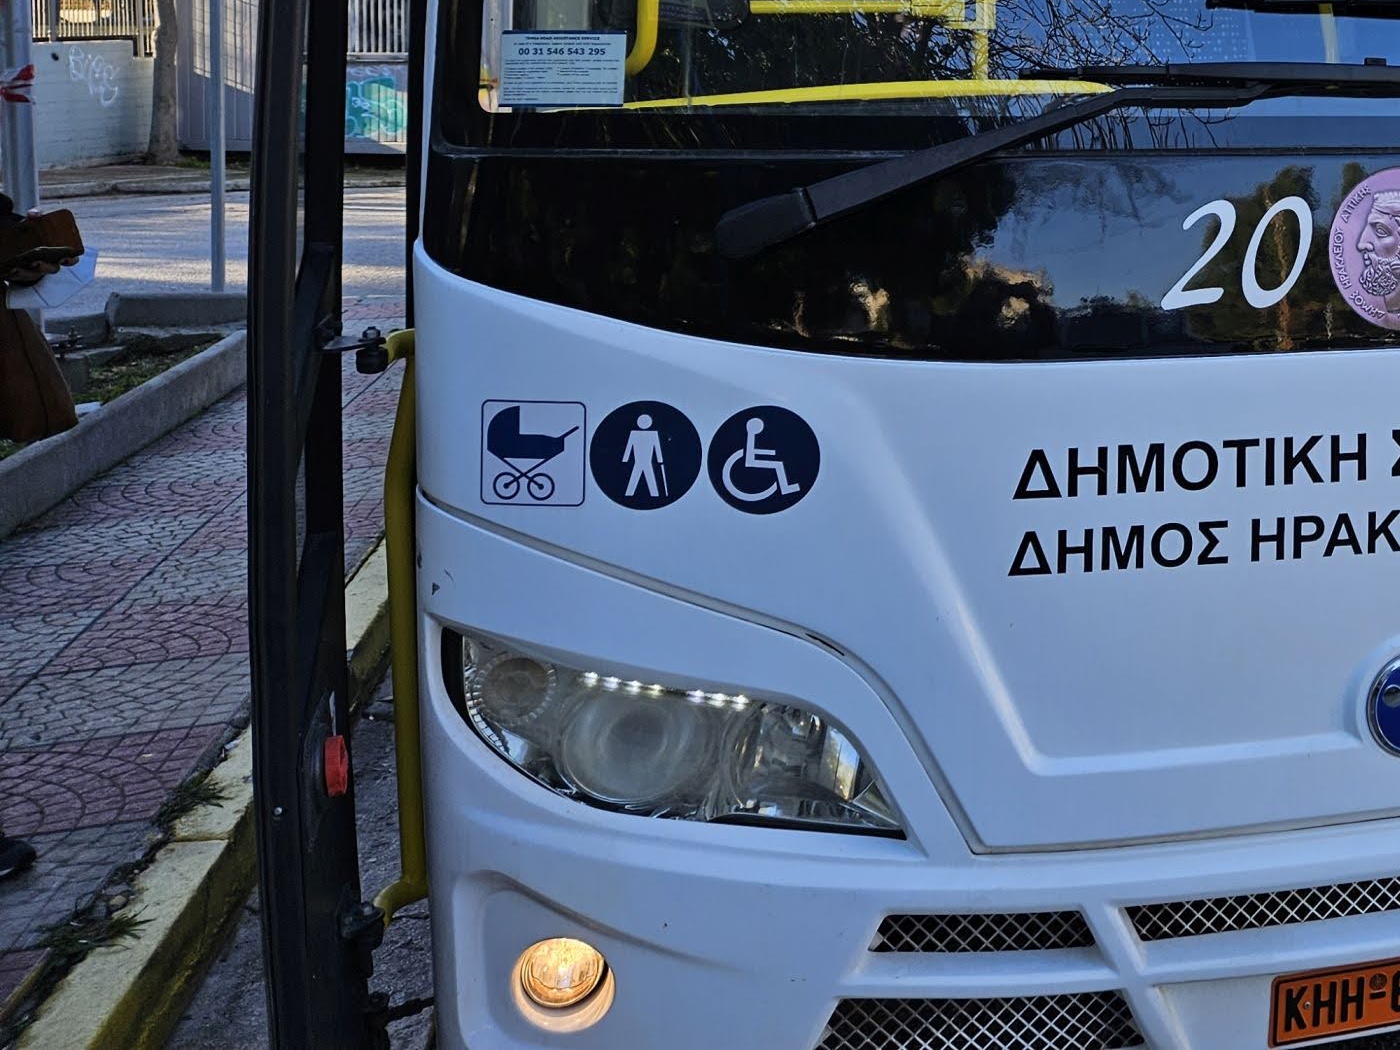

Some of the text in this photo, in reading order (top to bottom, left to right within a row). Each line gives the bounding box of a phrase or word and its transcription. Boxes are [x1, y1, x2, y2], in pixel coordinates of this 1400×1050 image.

[518, 47, 606, 56] 00 31 546 543 295
[1160, 196, 1313, 311] 20
[1012, 433, 1367, 500] ΔΗΜΟΤΙΚΗ
[1007, 520, 1229, 576] ΔΗΜΟΣ
